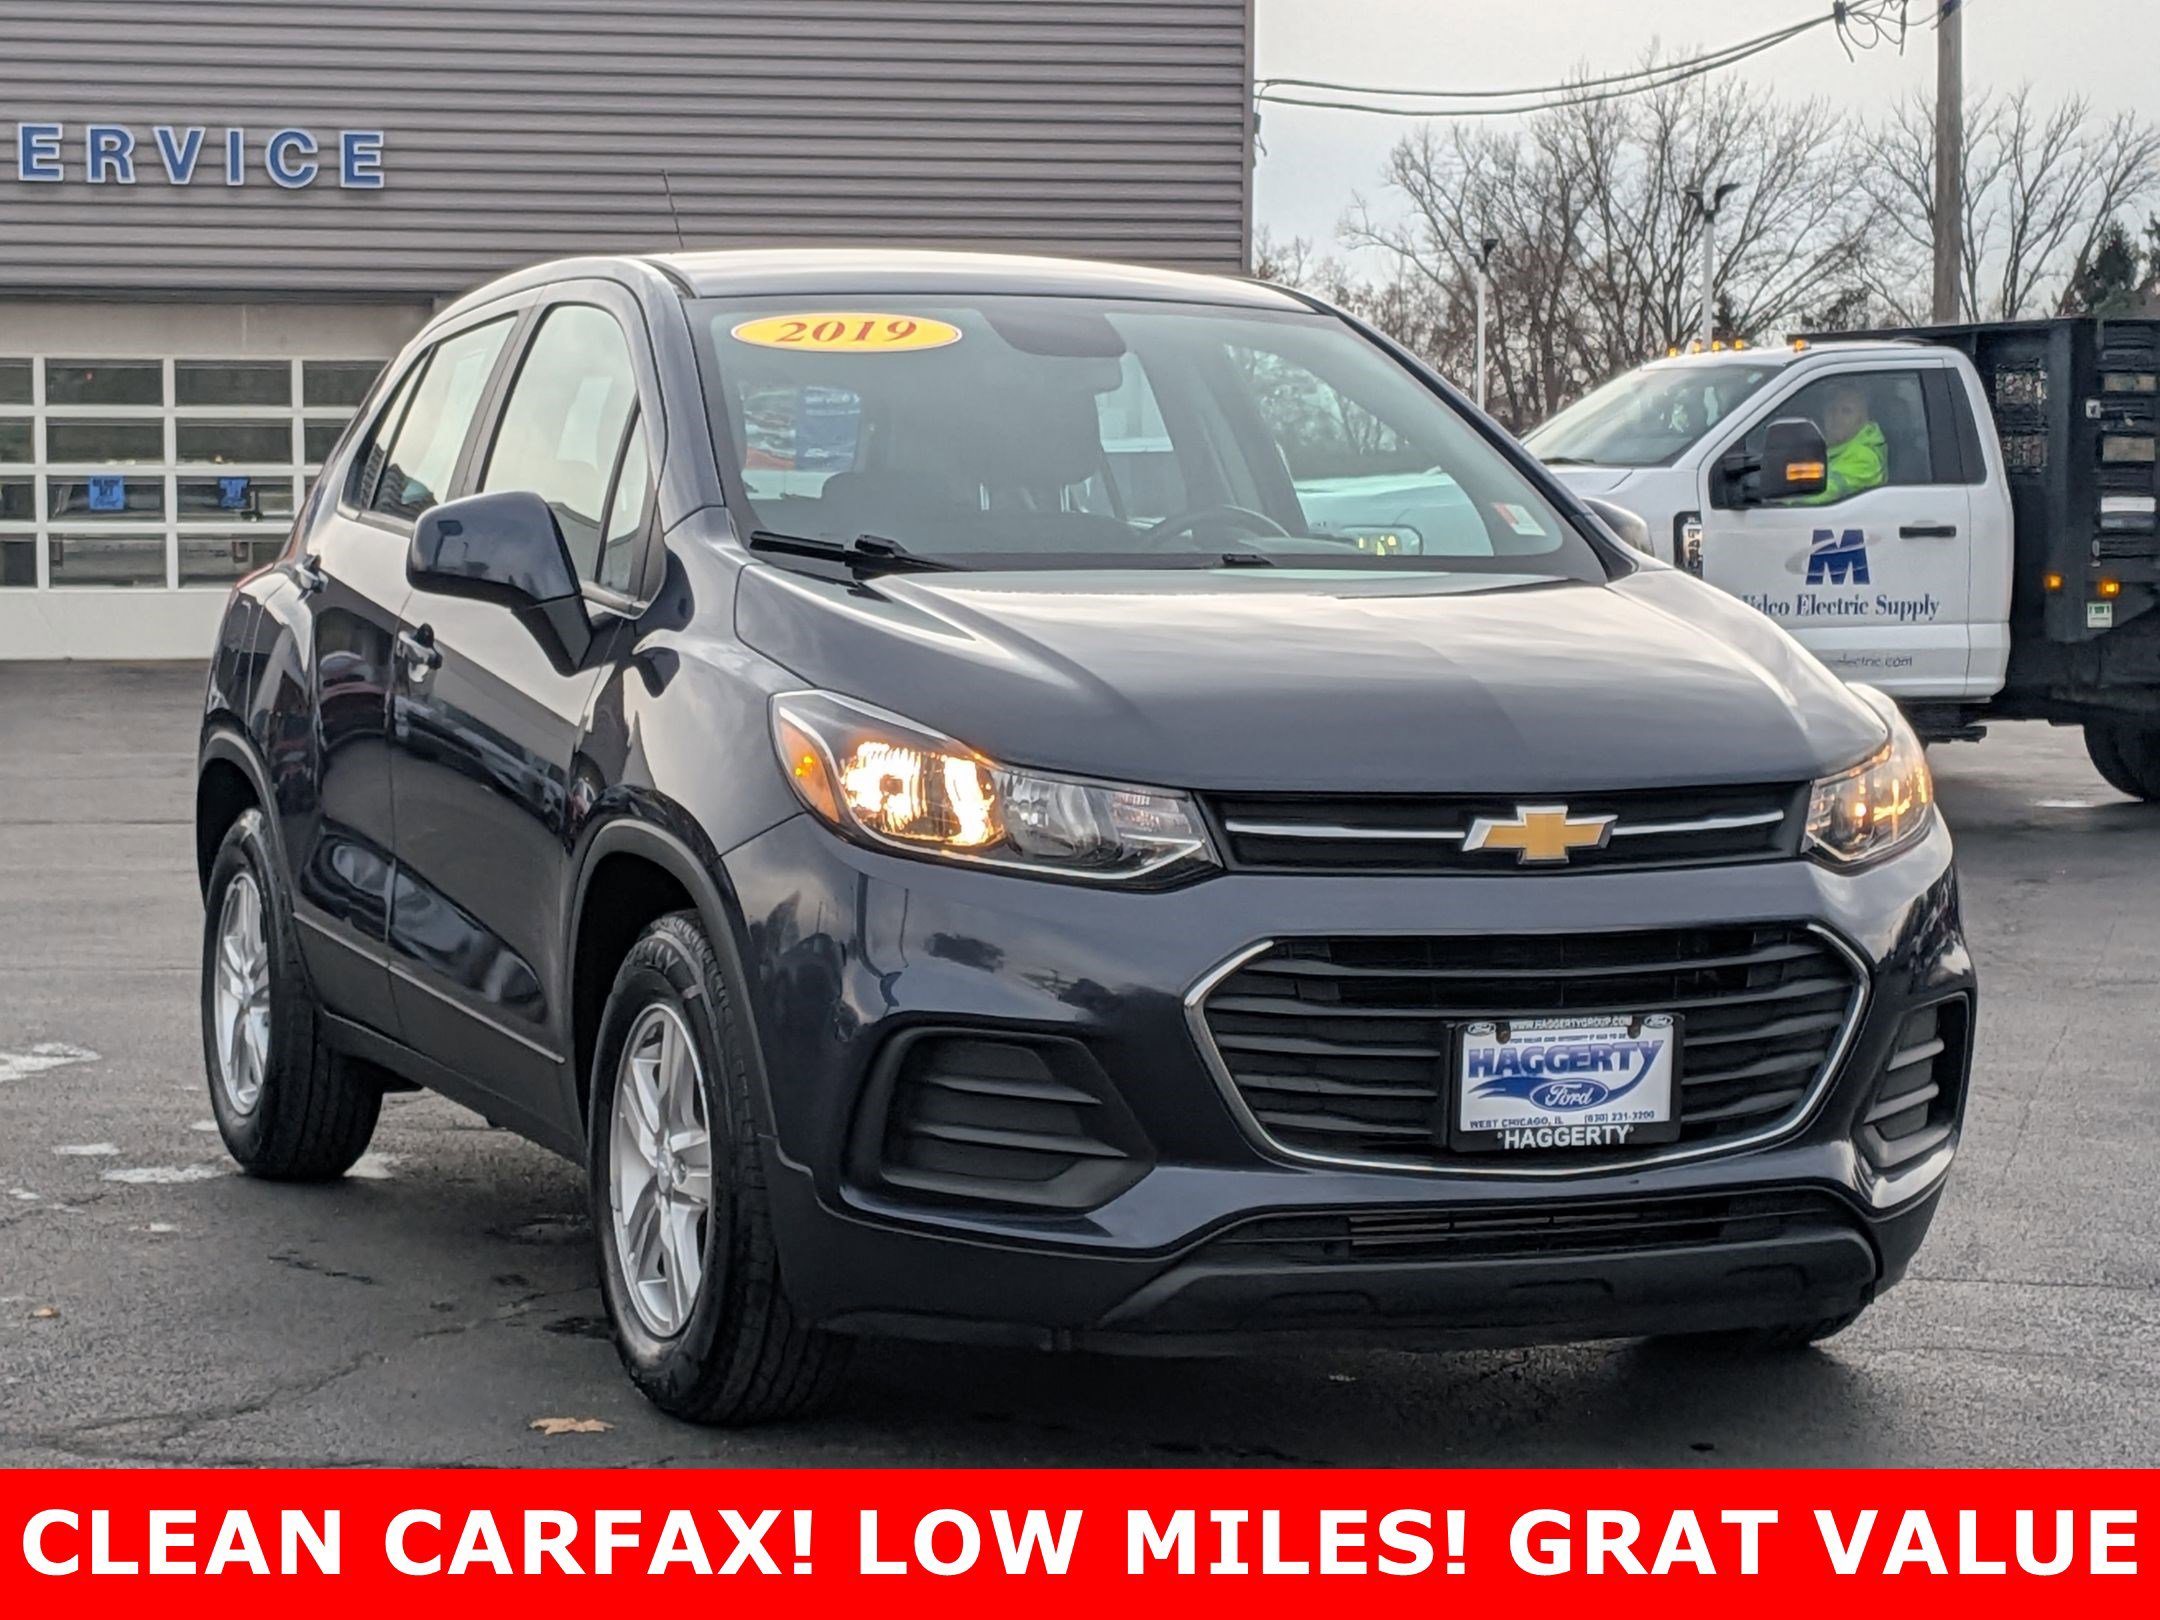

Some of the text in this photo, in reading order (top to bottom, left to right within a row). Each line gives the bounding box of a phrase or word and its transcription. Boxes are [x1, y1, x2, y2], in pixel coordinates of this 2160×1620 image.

[18, 122, 385, 189] ERVICE
[775, 320, 918, 343] 2019
[1796, 593, 1869, 617] Electric
[1875, 593, 1940, 621] Supply
[1468, 1041, 1664, 1079] HAGGERTY
[1545, 1083, 1593, 1107] Ford
[1470, 1119, 1498, 1129] WEST
[1504, 1125, 1630, 1150] HAGGERTY
